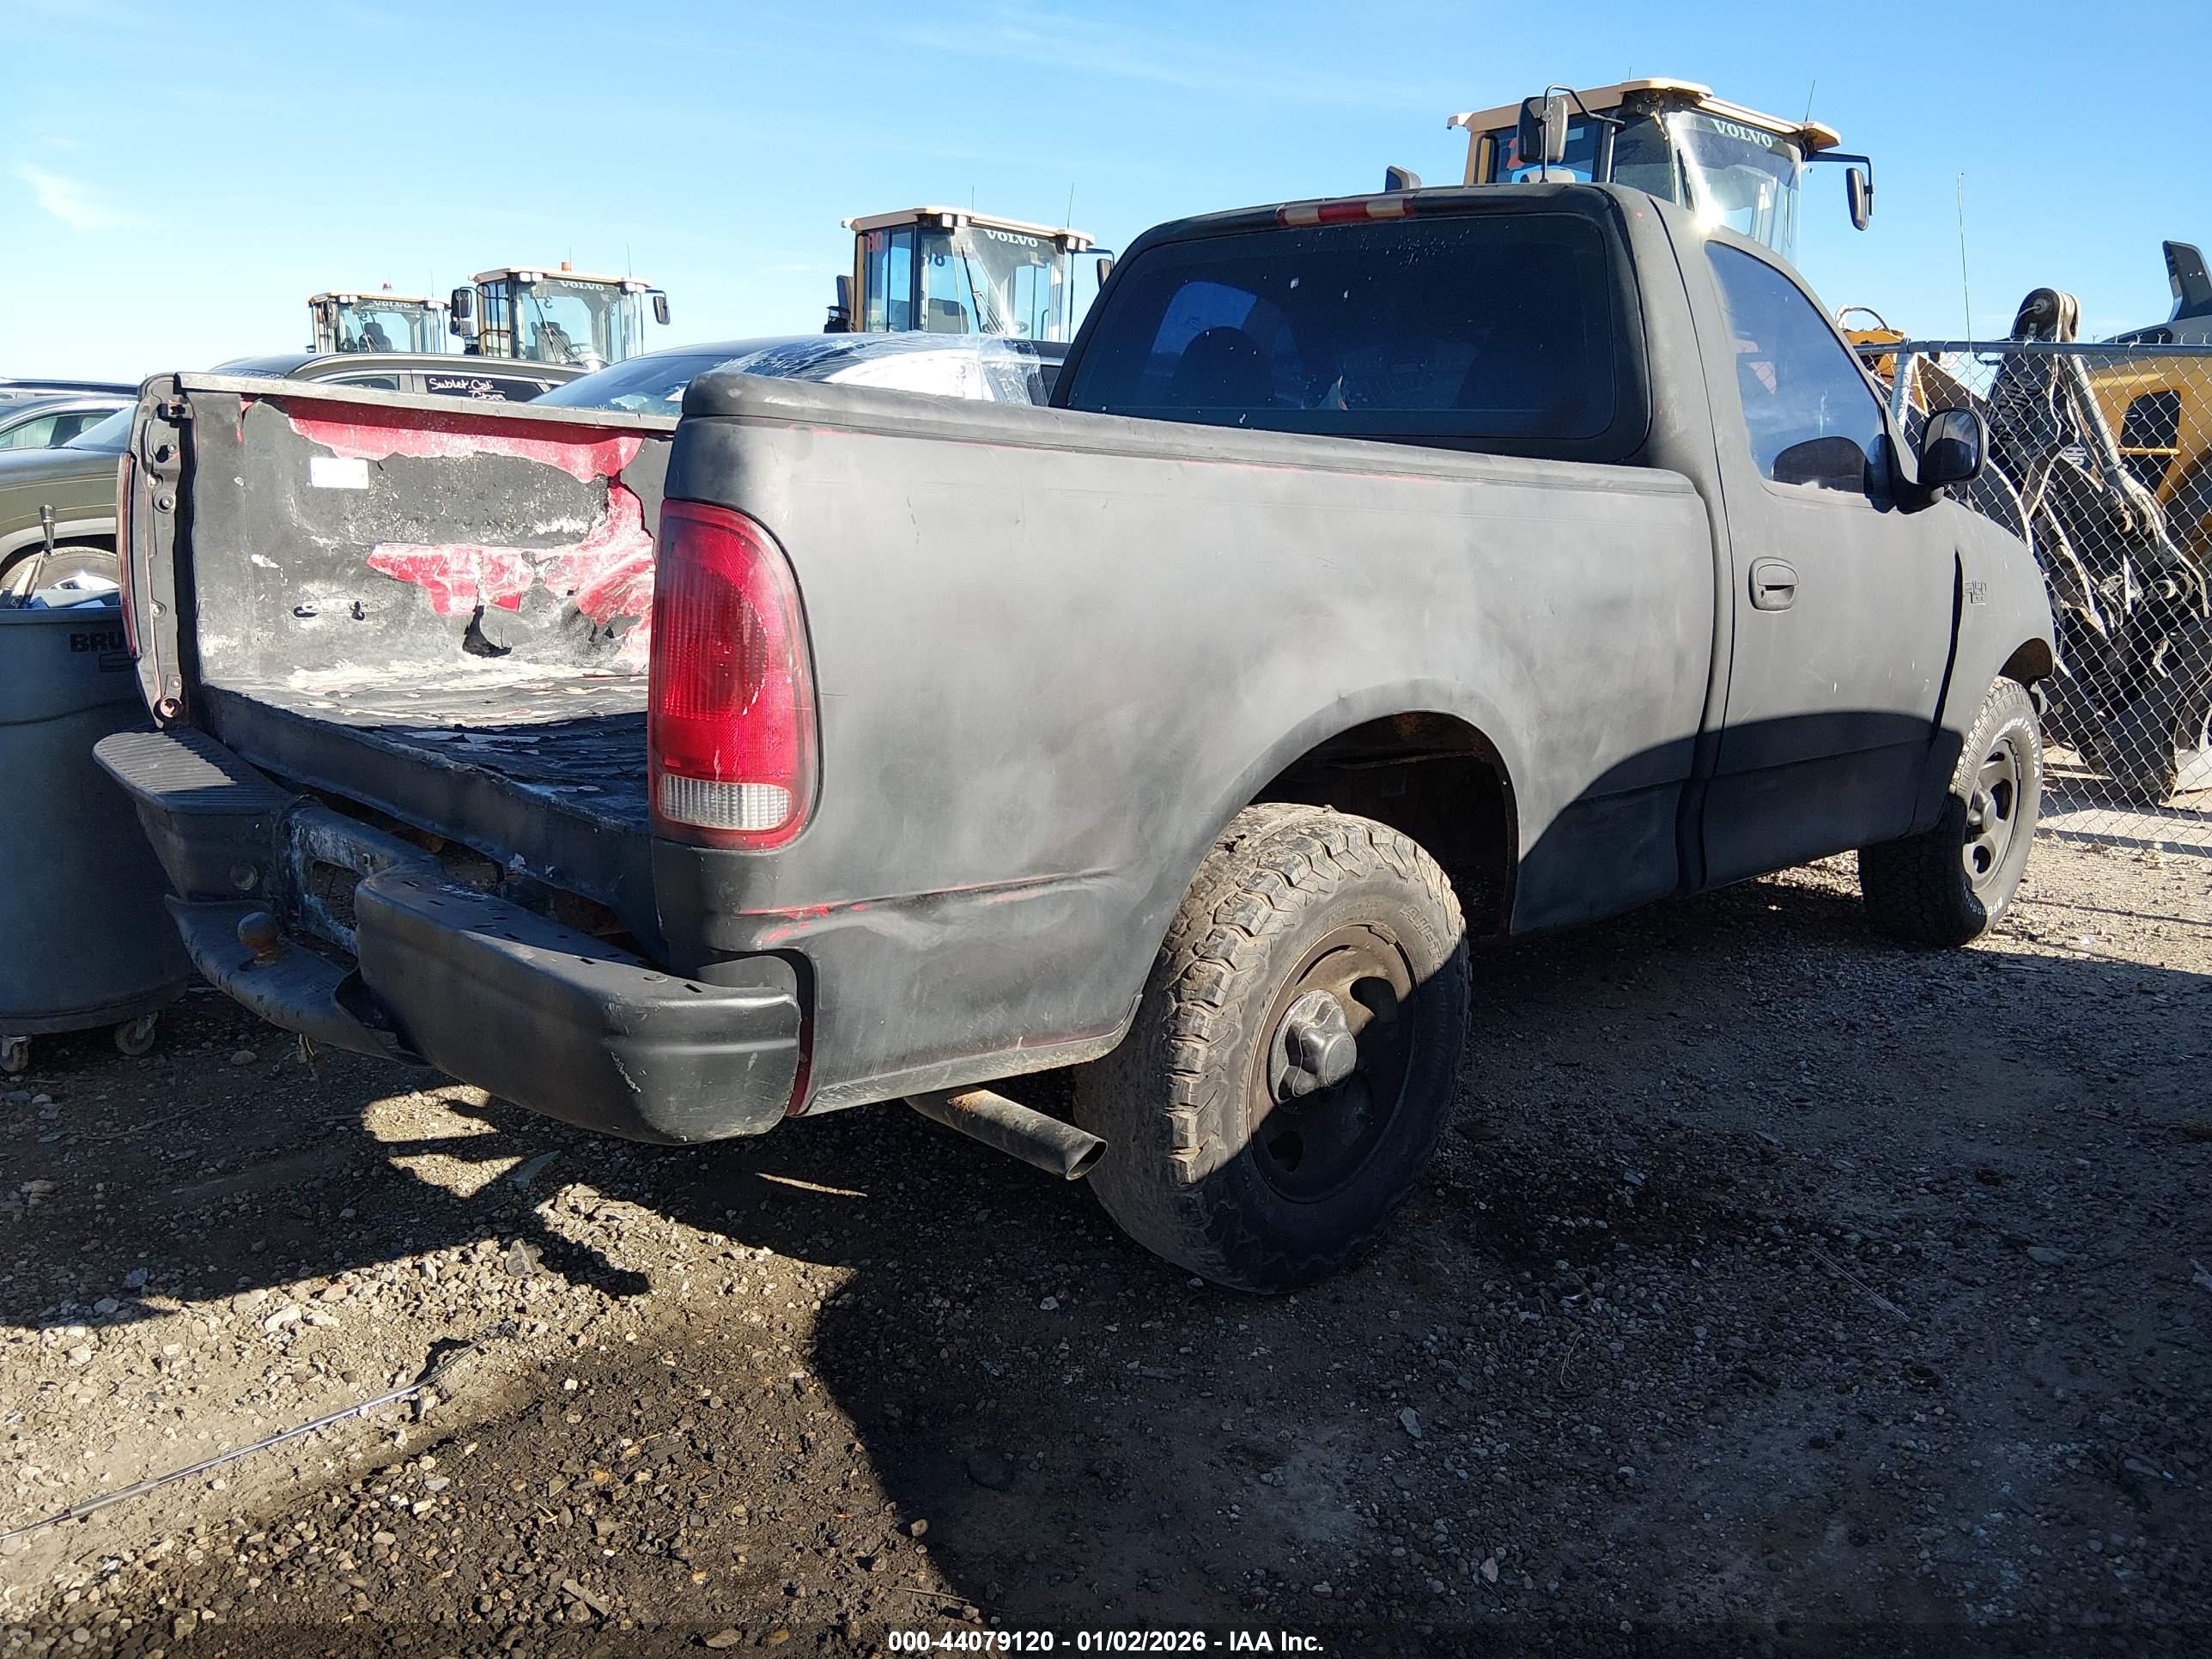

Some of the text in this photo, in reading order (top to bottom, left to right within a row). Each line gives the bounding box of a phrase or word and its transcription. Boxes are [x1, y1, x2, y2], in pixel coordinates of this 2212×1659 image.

[1711, 118, 1773, 148] VOLVO
[982, 229, 1038, 247] VOLVO
[559, 281, 605, 291] VOLVO
[70, 631, 126, 653] BRU
[2022, 720, 2038, 750] Trail
